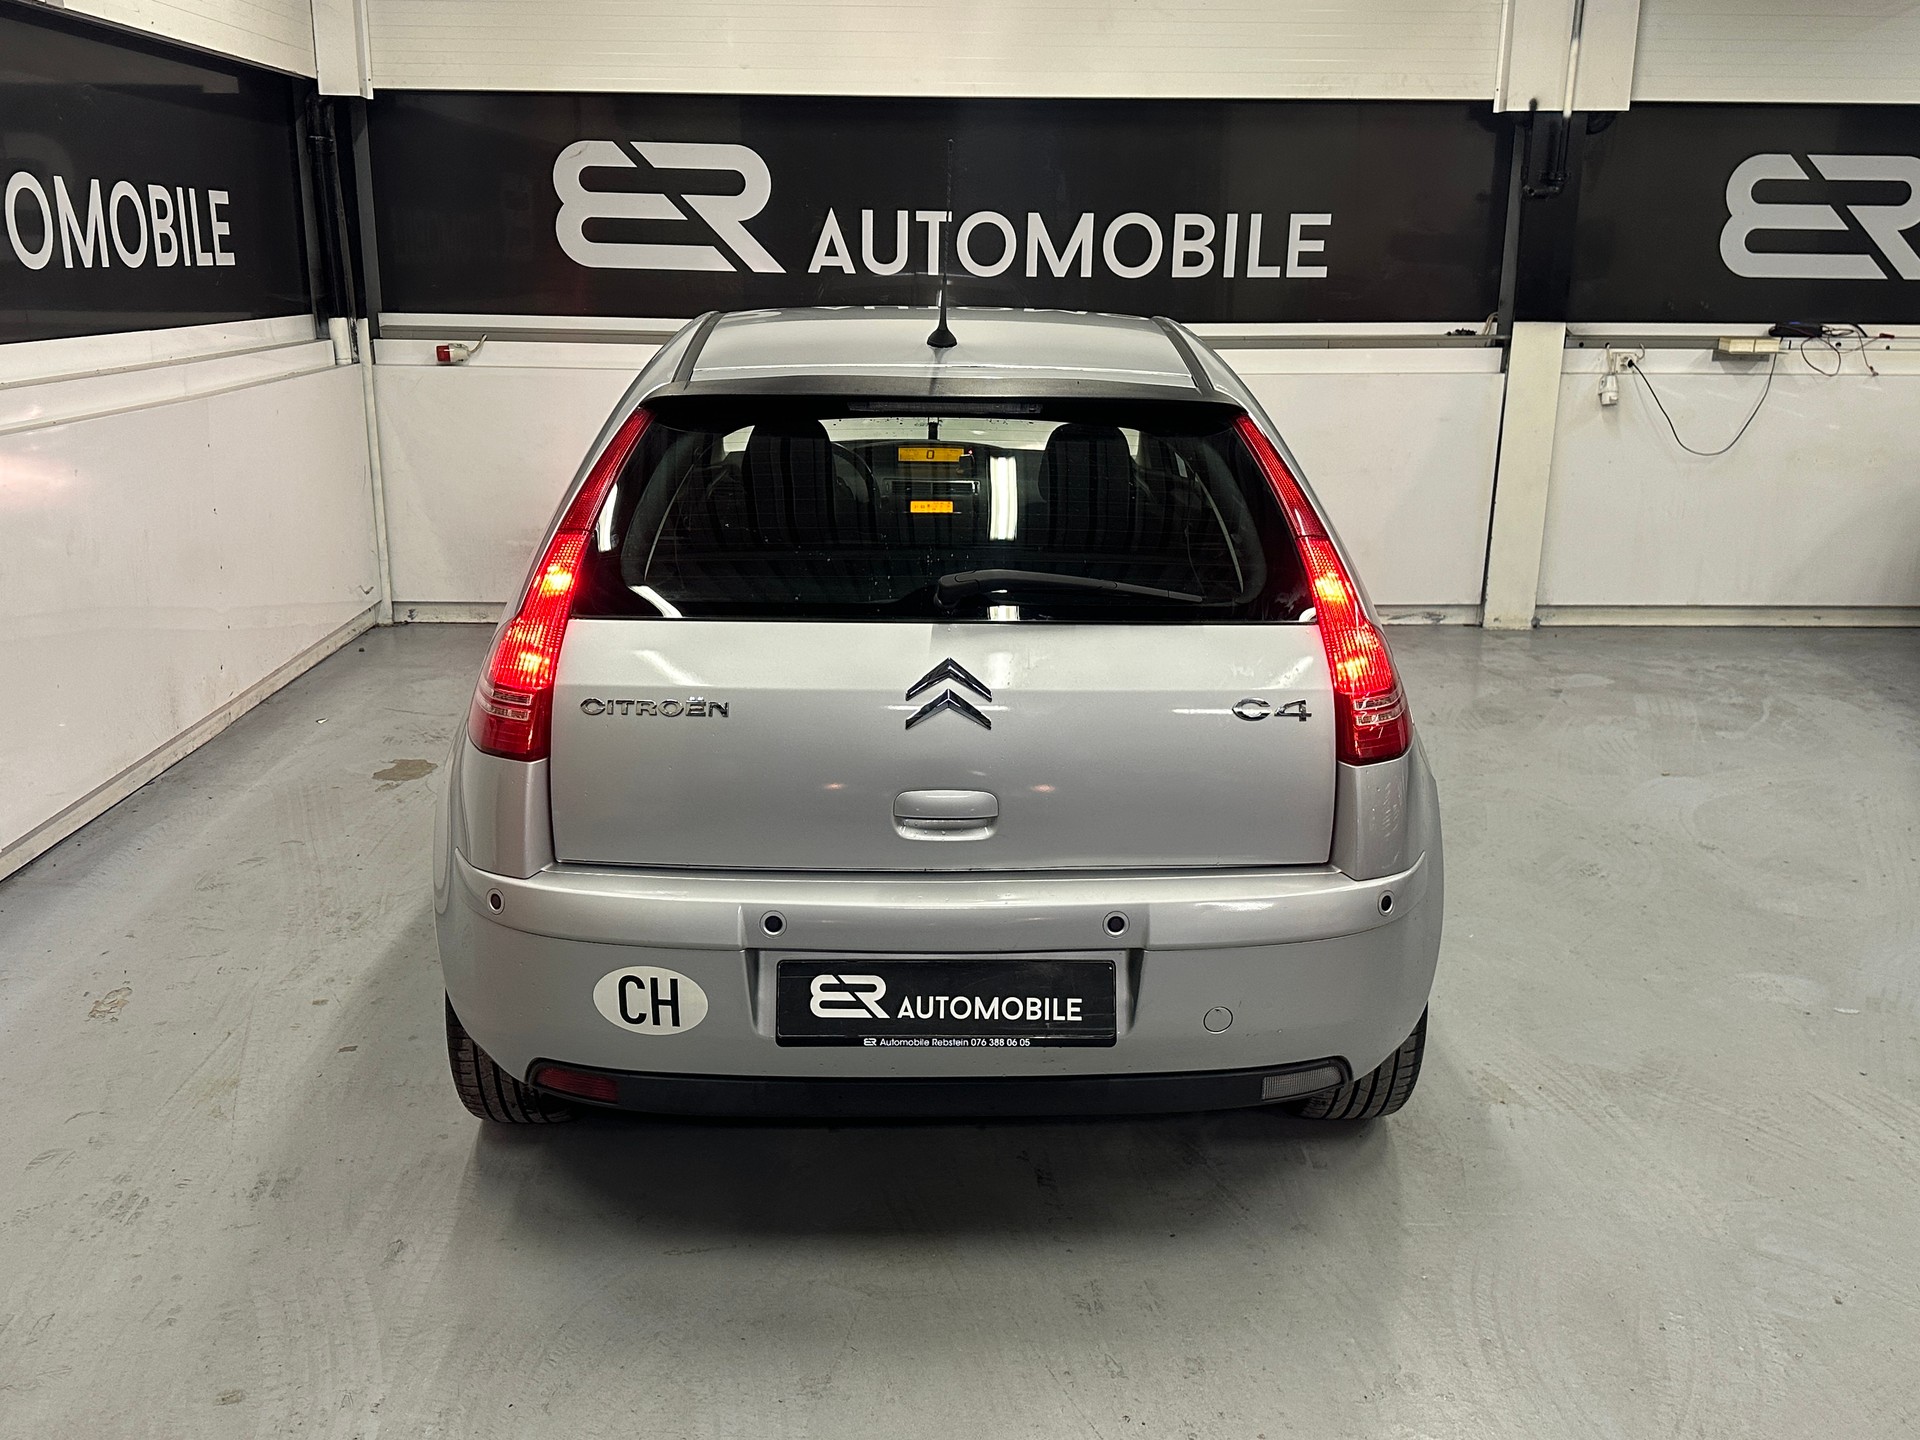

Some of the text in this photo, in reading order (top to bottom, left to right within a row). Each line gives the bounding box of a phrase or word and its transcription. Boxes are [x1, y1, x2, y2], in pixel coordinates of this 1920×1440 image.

[5, 171, 236, 270] OMOBILE
[807, 207, 1332, 279] AUTOMOBILE
[580, 697, 730, 718] CITROËN
[1231, 697, 1312, 722] C4
[618, 974, 681, 1027] CH
[897, 996, 1083, 1022] AUTOMOBILE
[879, 1038, 930, 1047] Automobile
[931, 1038, 969, 1047] Rebstein
[970, 1038, 987, 1047] 076
[988, 1038, 1005, 1047] 388
[1006, 1038, 1018, 1047] 06
[1019, 1038, 1031, 1047] 05
